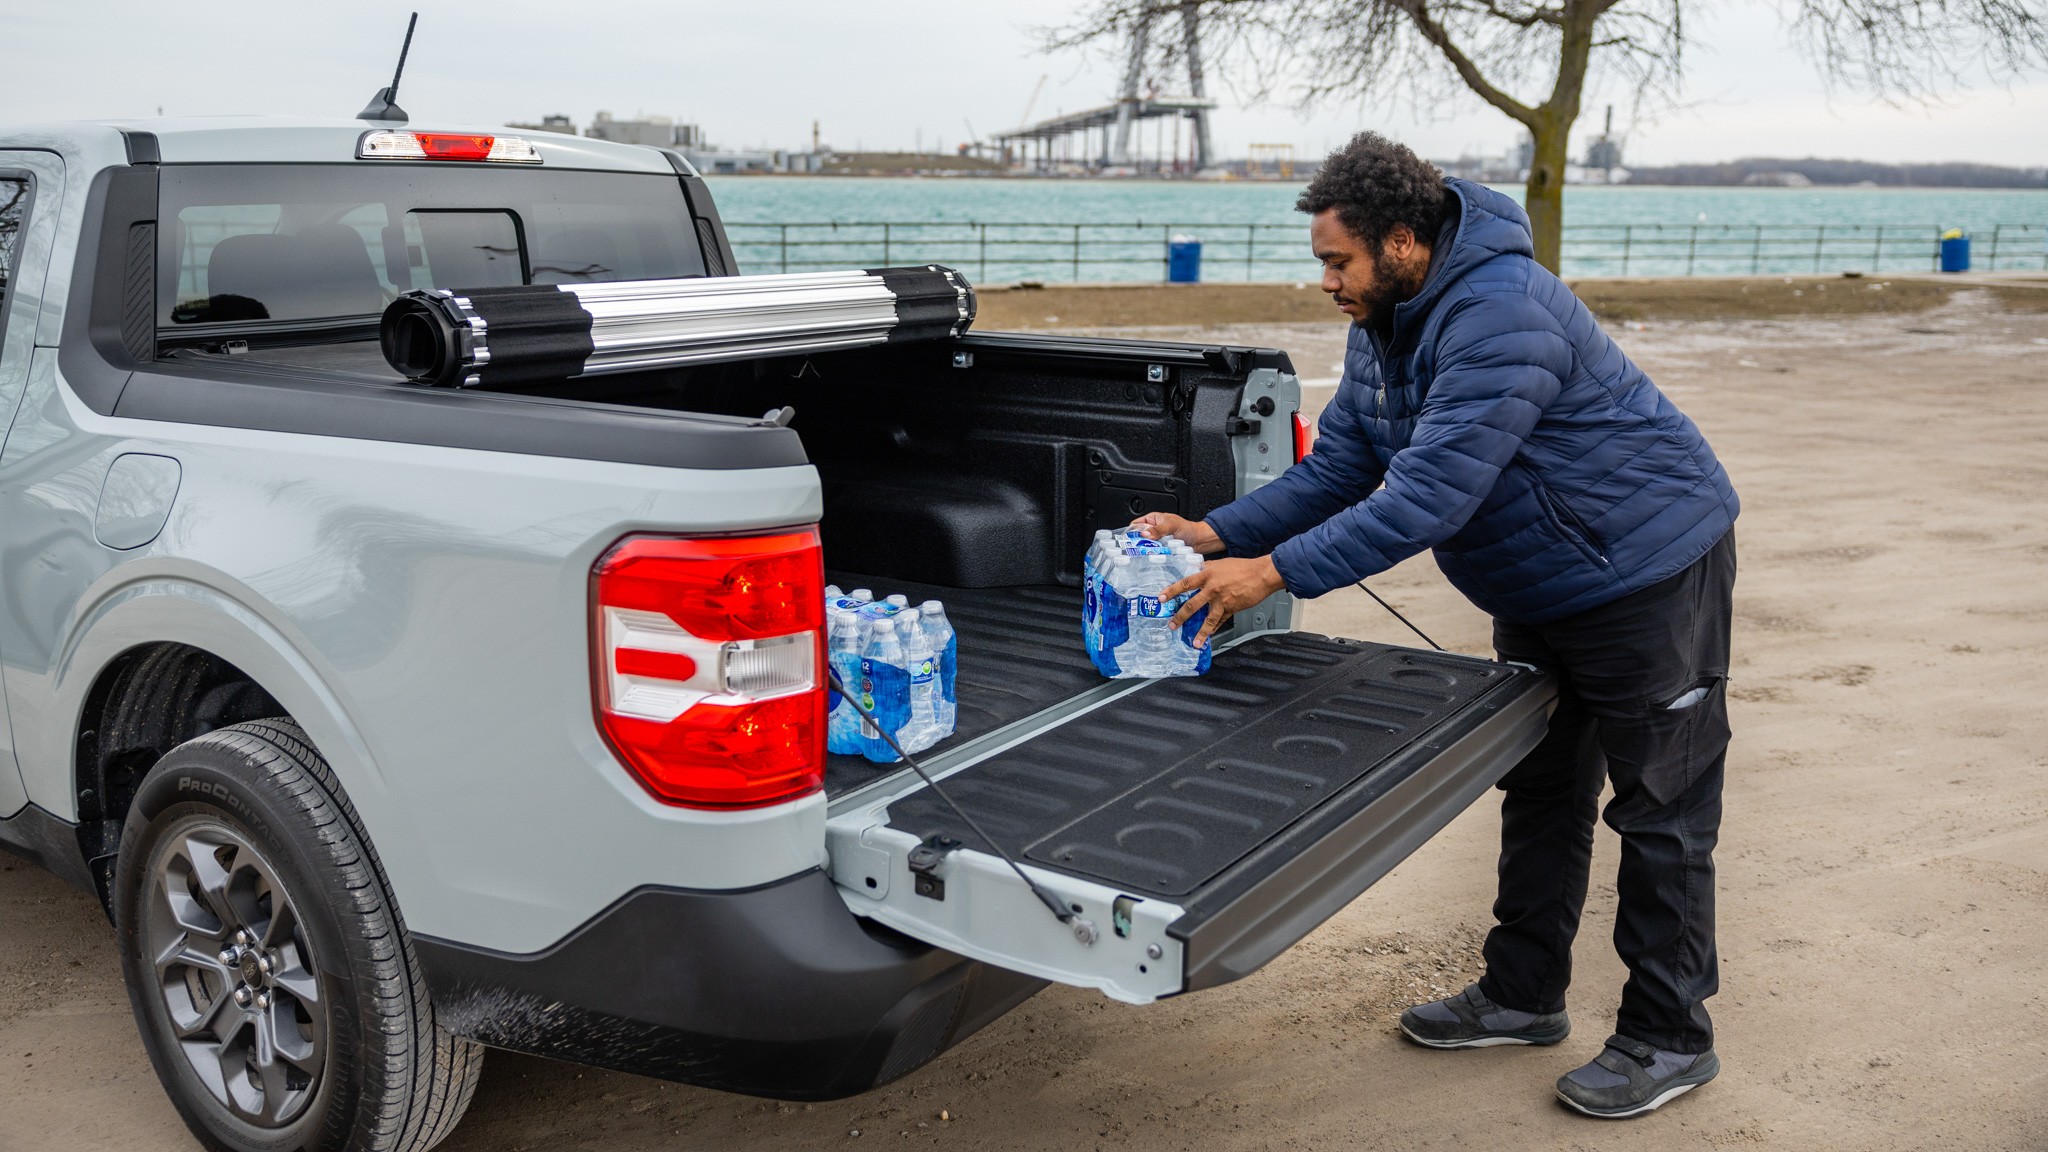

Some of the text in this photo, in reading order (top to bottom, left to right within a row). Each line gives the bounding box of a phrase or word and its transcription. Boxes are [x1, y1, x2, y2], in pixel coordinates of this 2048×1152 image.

[1143, 597, 1159, 607] Pure
[1144, 601, 1157, 612] Life
[862, 661, 870, 670] 12
